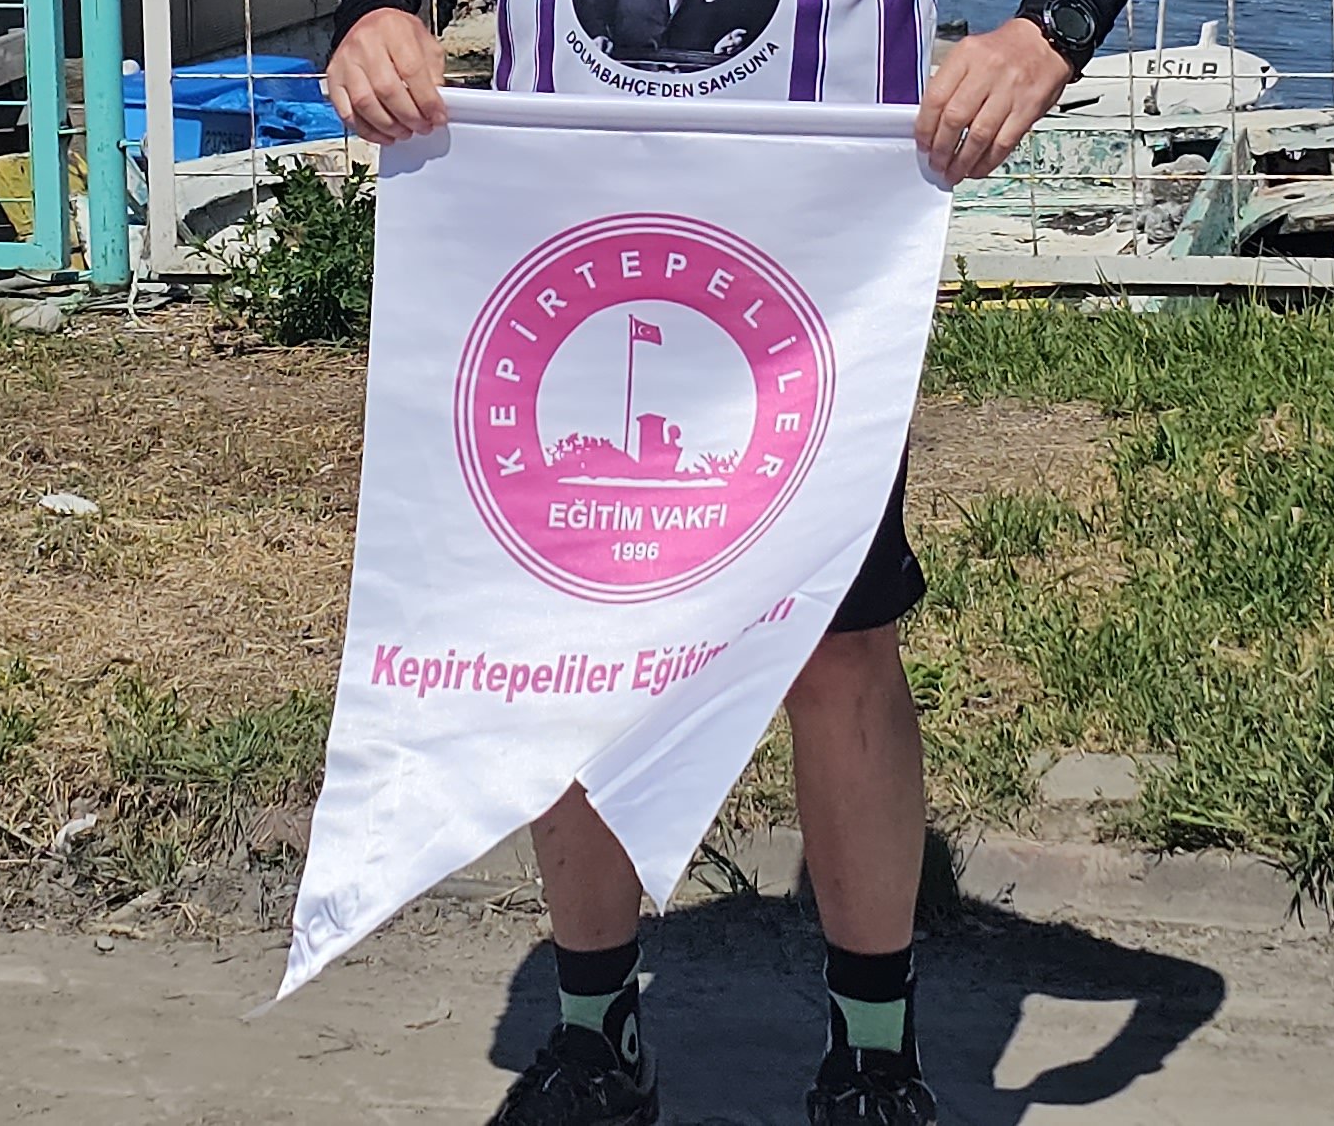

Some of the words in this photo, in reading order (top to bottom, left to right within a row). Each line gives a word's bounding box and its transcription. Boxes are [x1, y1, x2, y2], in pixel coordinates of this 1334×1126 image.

[566, 30, 694, 97] DOLMABAHÇE'DEN
[698, 41, 780, 96] SAMSUN'A
[490, 251, 803, 478] KEPİRTEPELİLER
[548, 498, 643, 532] EĞİTİM
[650, 503, 729, 531] VAKFI
[611, 541, 660, 561] 1996
[371, 643, 625, 703] Kepirtepeliler
